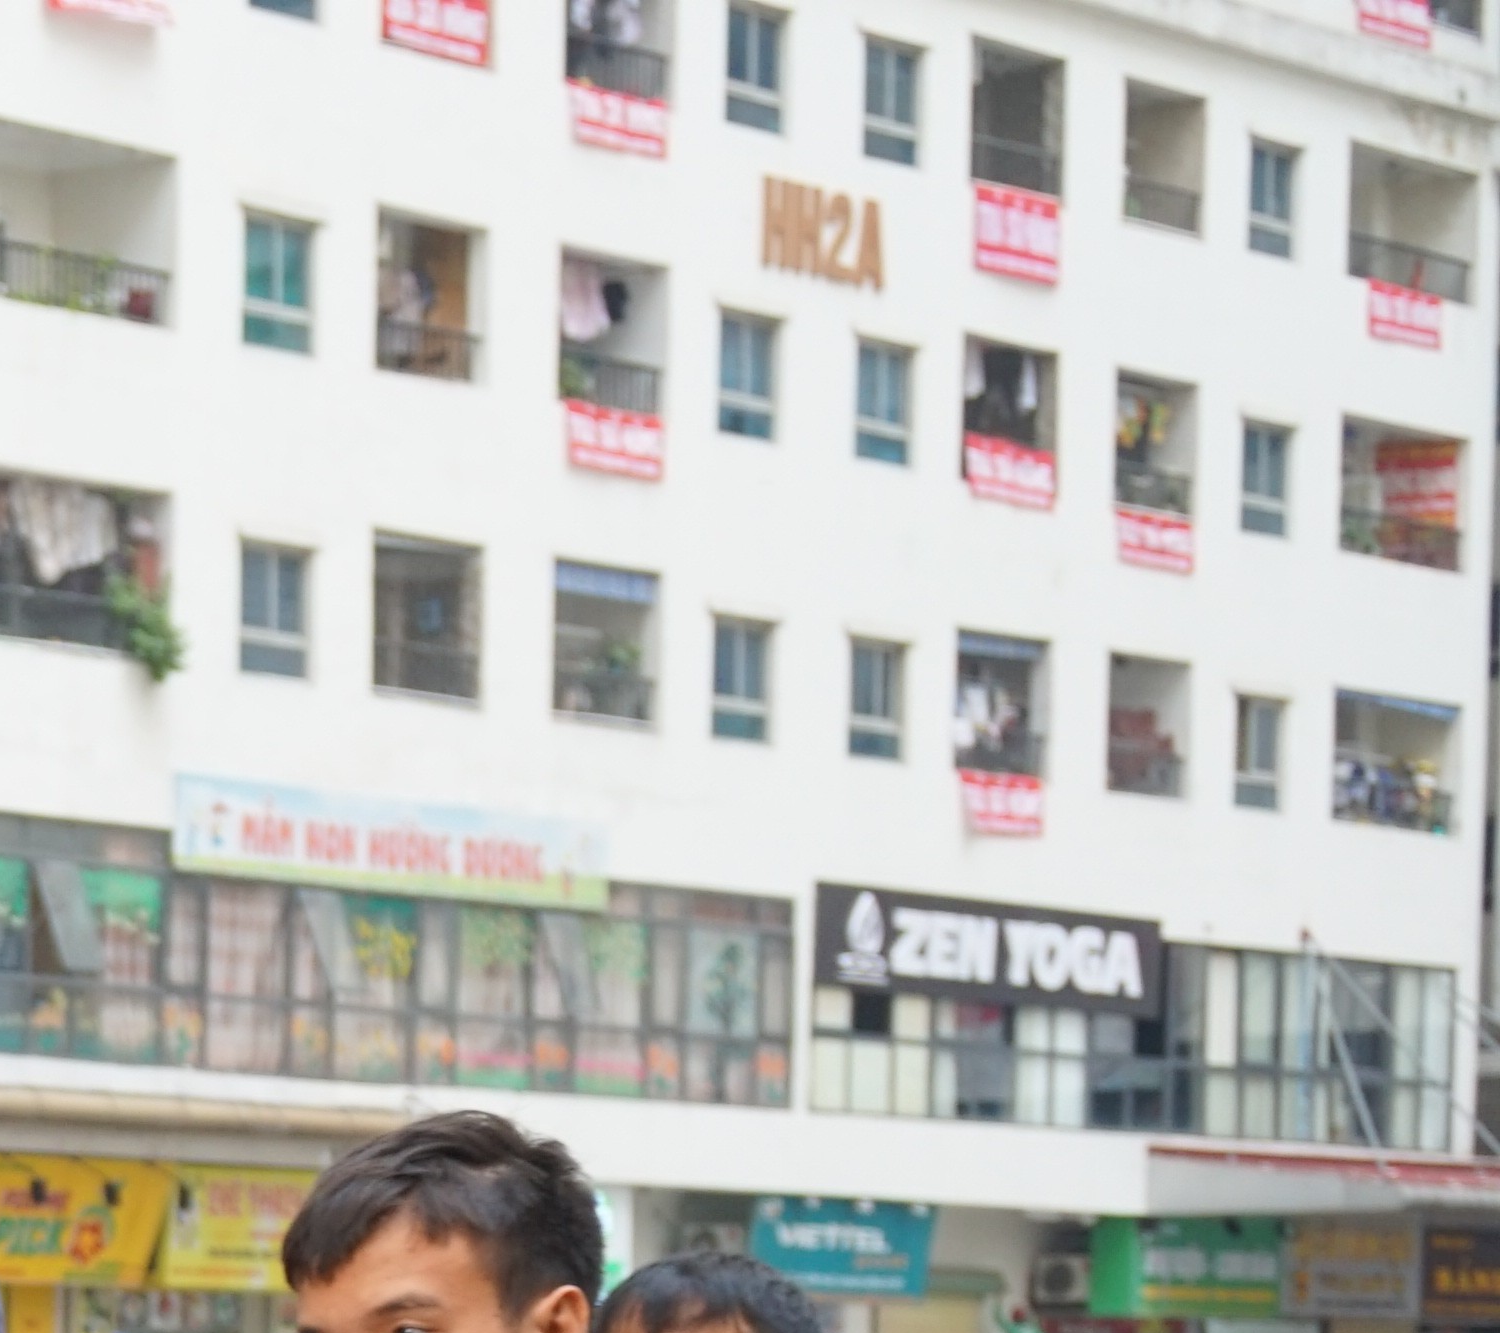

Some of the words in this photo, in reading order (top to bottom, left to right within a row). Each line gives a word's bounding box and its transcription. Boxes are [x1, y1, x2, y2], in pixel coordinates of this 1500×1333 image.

[762, 174, 884, 291] HH2A
[304, 820, 356, 862] NON
[889, 905, 998, 985] ZEN
[1003, 917, 1145, 999] YOGA
